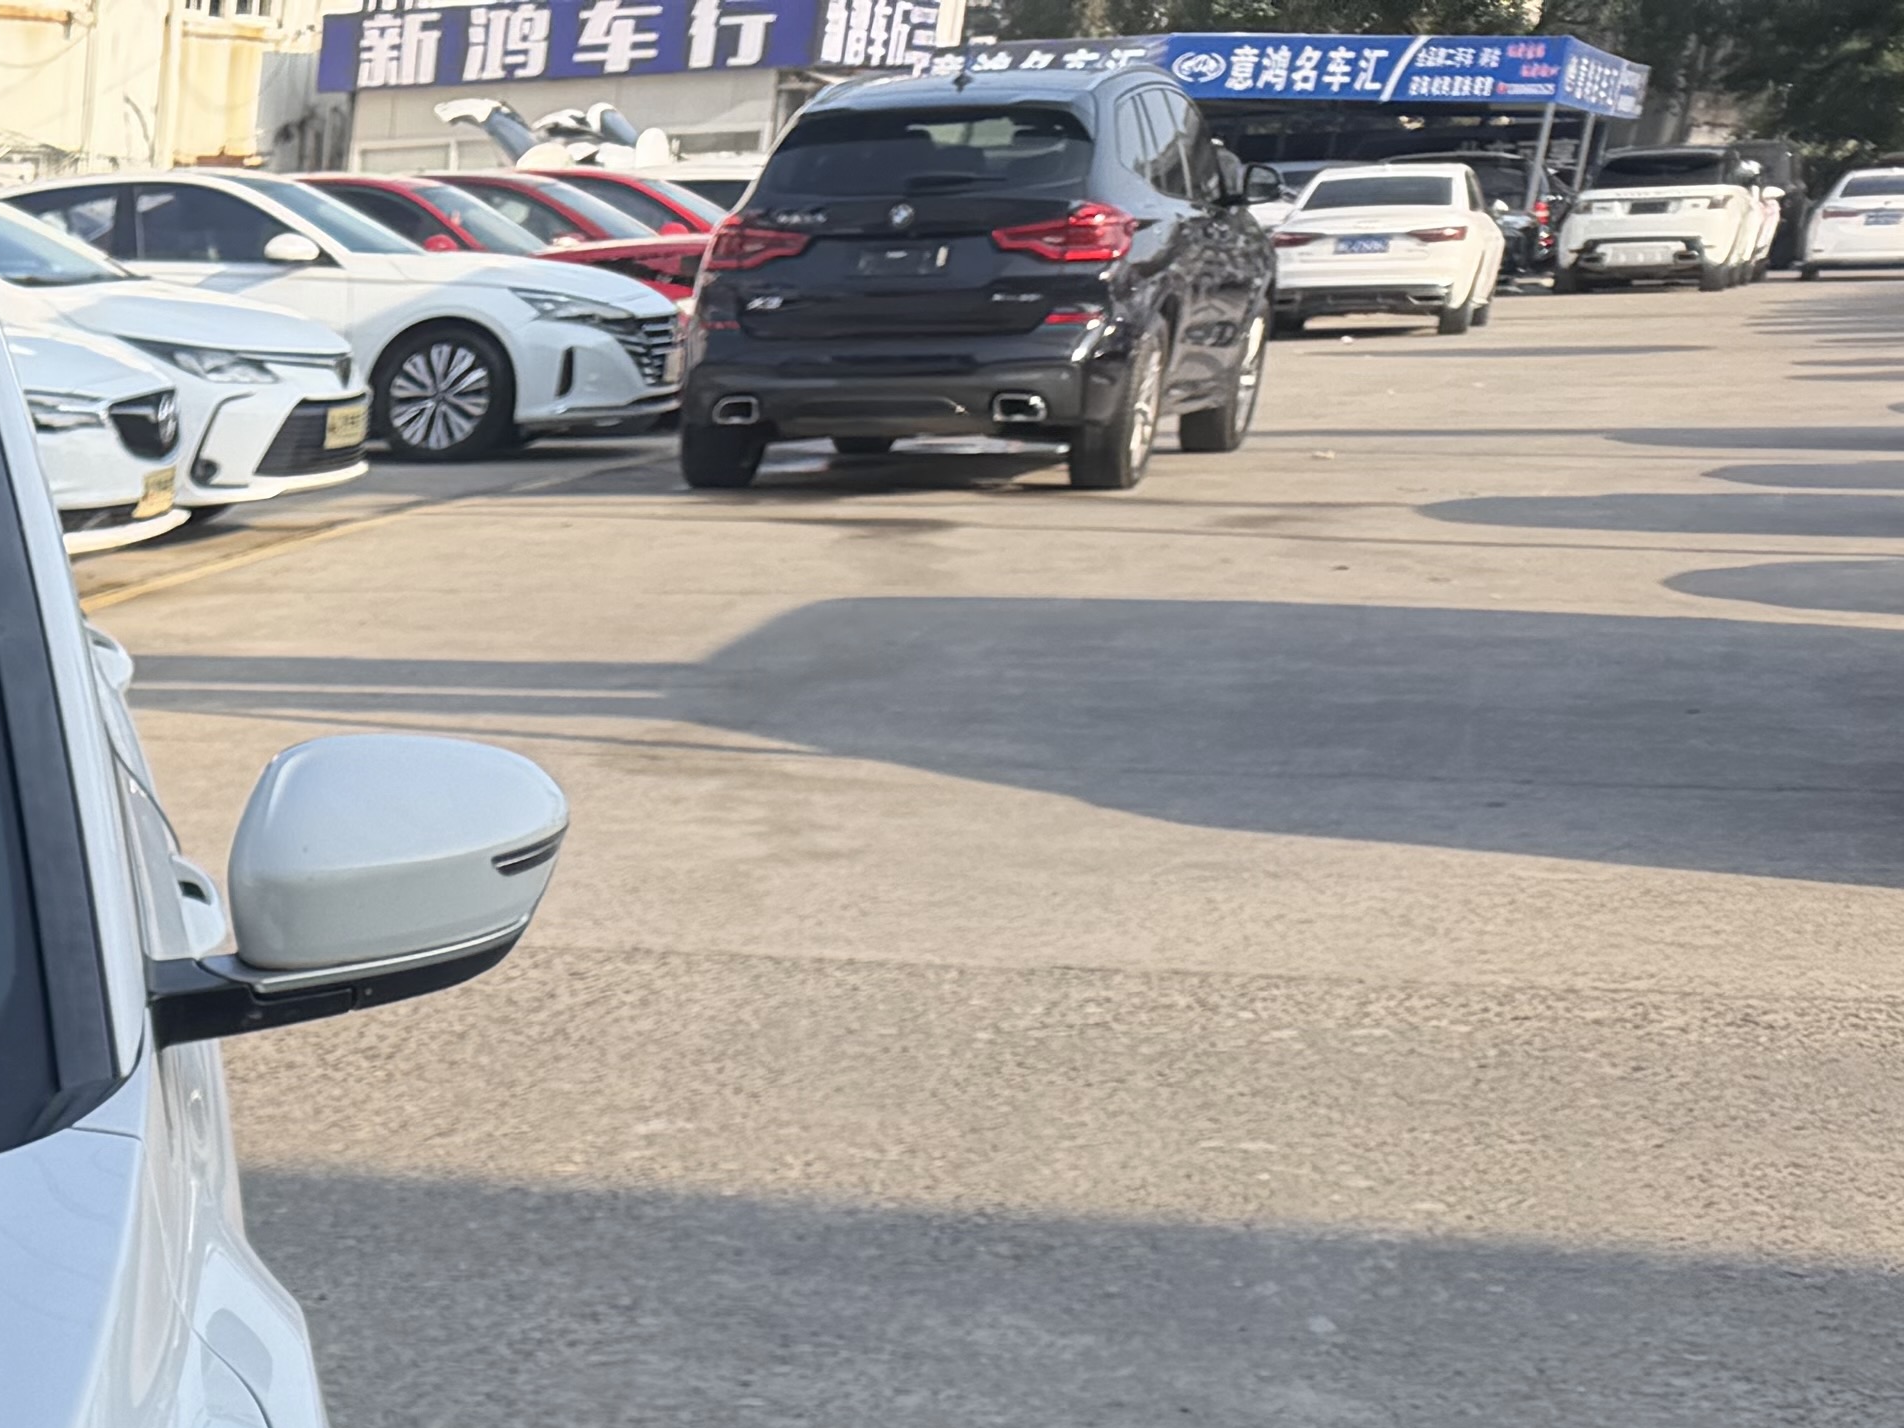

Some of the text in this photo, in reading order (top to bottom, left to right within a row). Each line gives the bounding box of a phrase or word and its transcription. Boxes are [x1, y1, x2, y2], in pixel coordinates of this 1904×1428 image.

[356, 0, 778, 88] 新鸿车行
[1224, 45, 1390, 92] 意鸿名车汇
